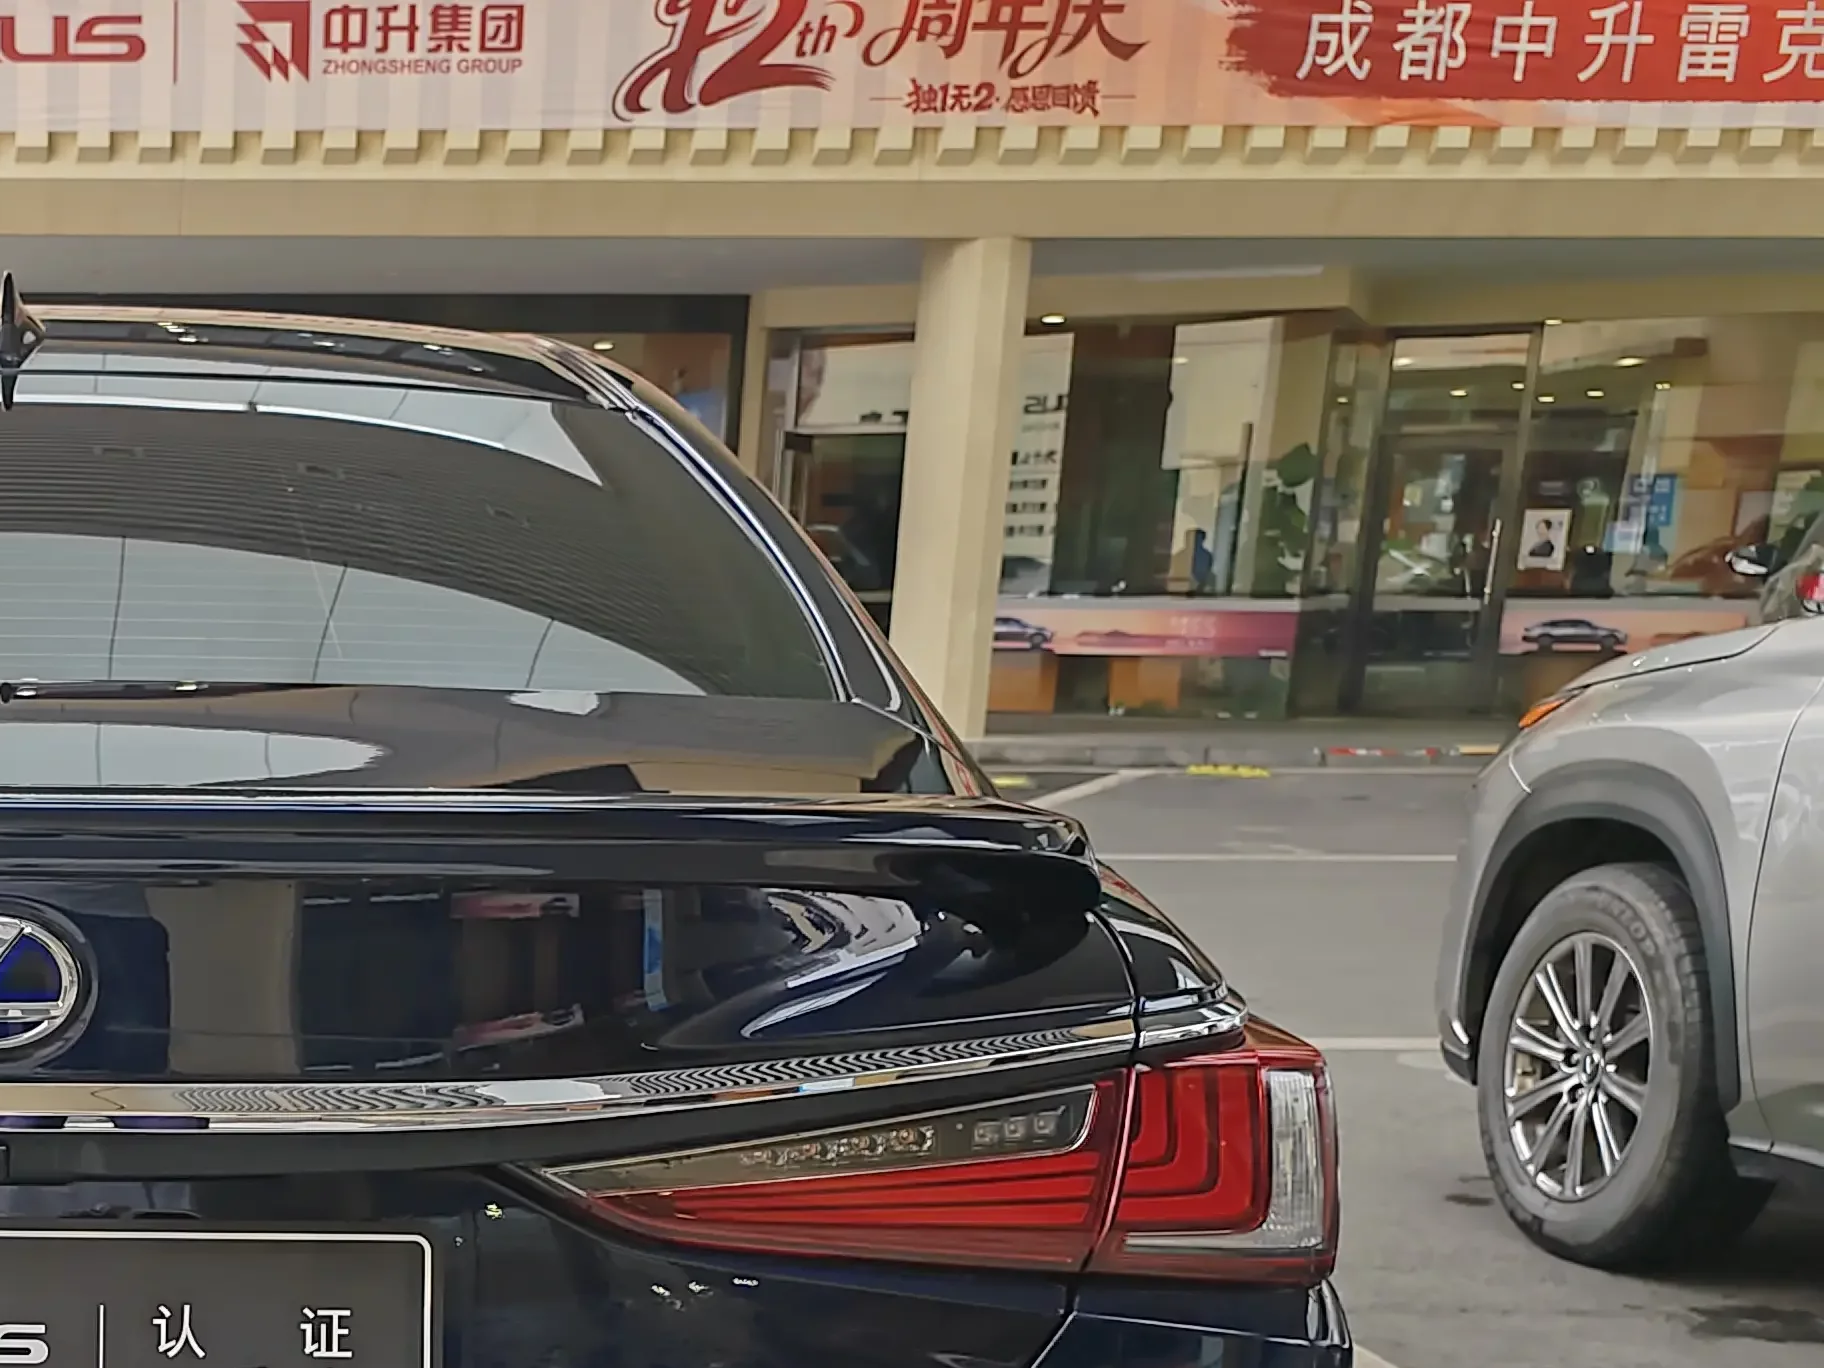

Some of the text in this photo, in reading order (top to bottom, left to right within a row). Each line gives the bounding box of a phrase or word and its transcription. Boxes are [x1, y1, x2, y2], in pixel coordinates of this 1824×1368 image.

[323, 3, 525, 54] 中升集团
[1296, 0, 1824, 83] 成都中升雷克
[322, 58, 523, 75] ZHONGSHENG GROUP
